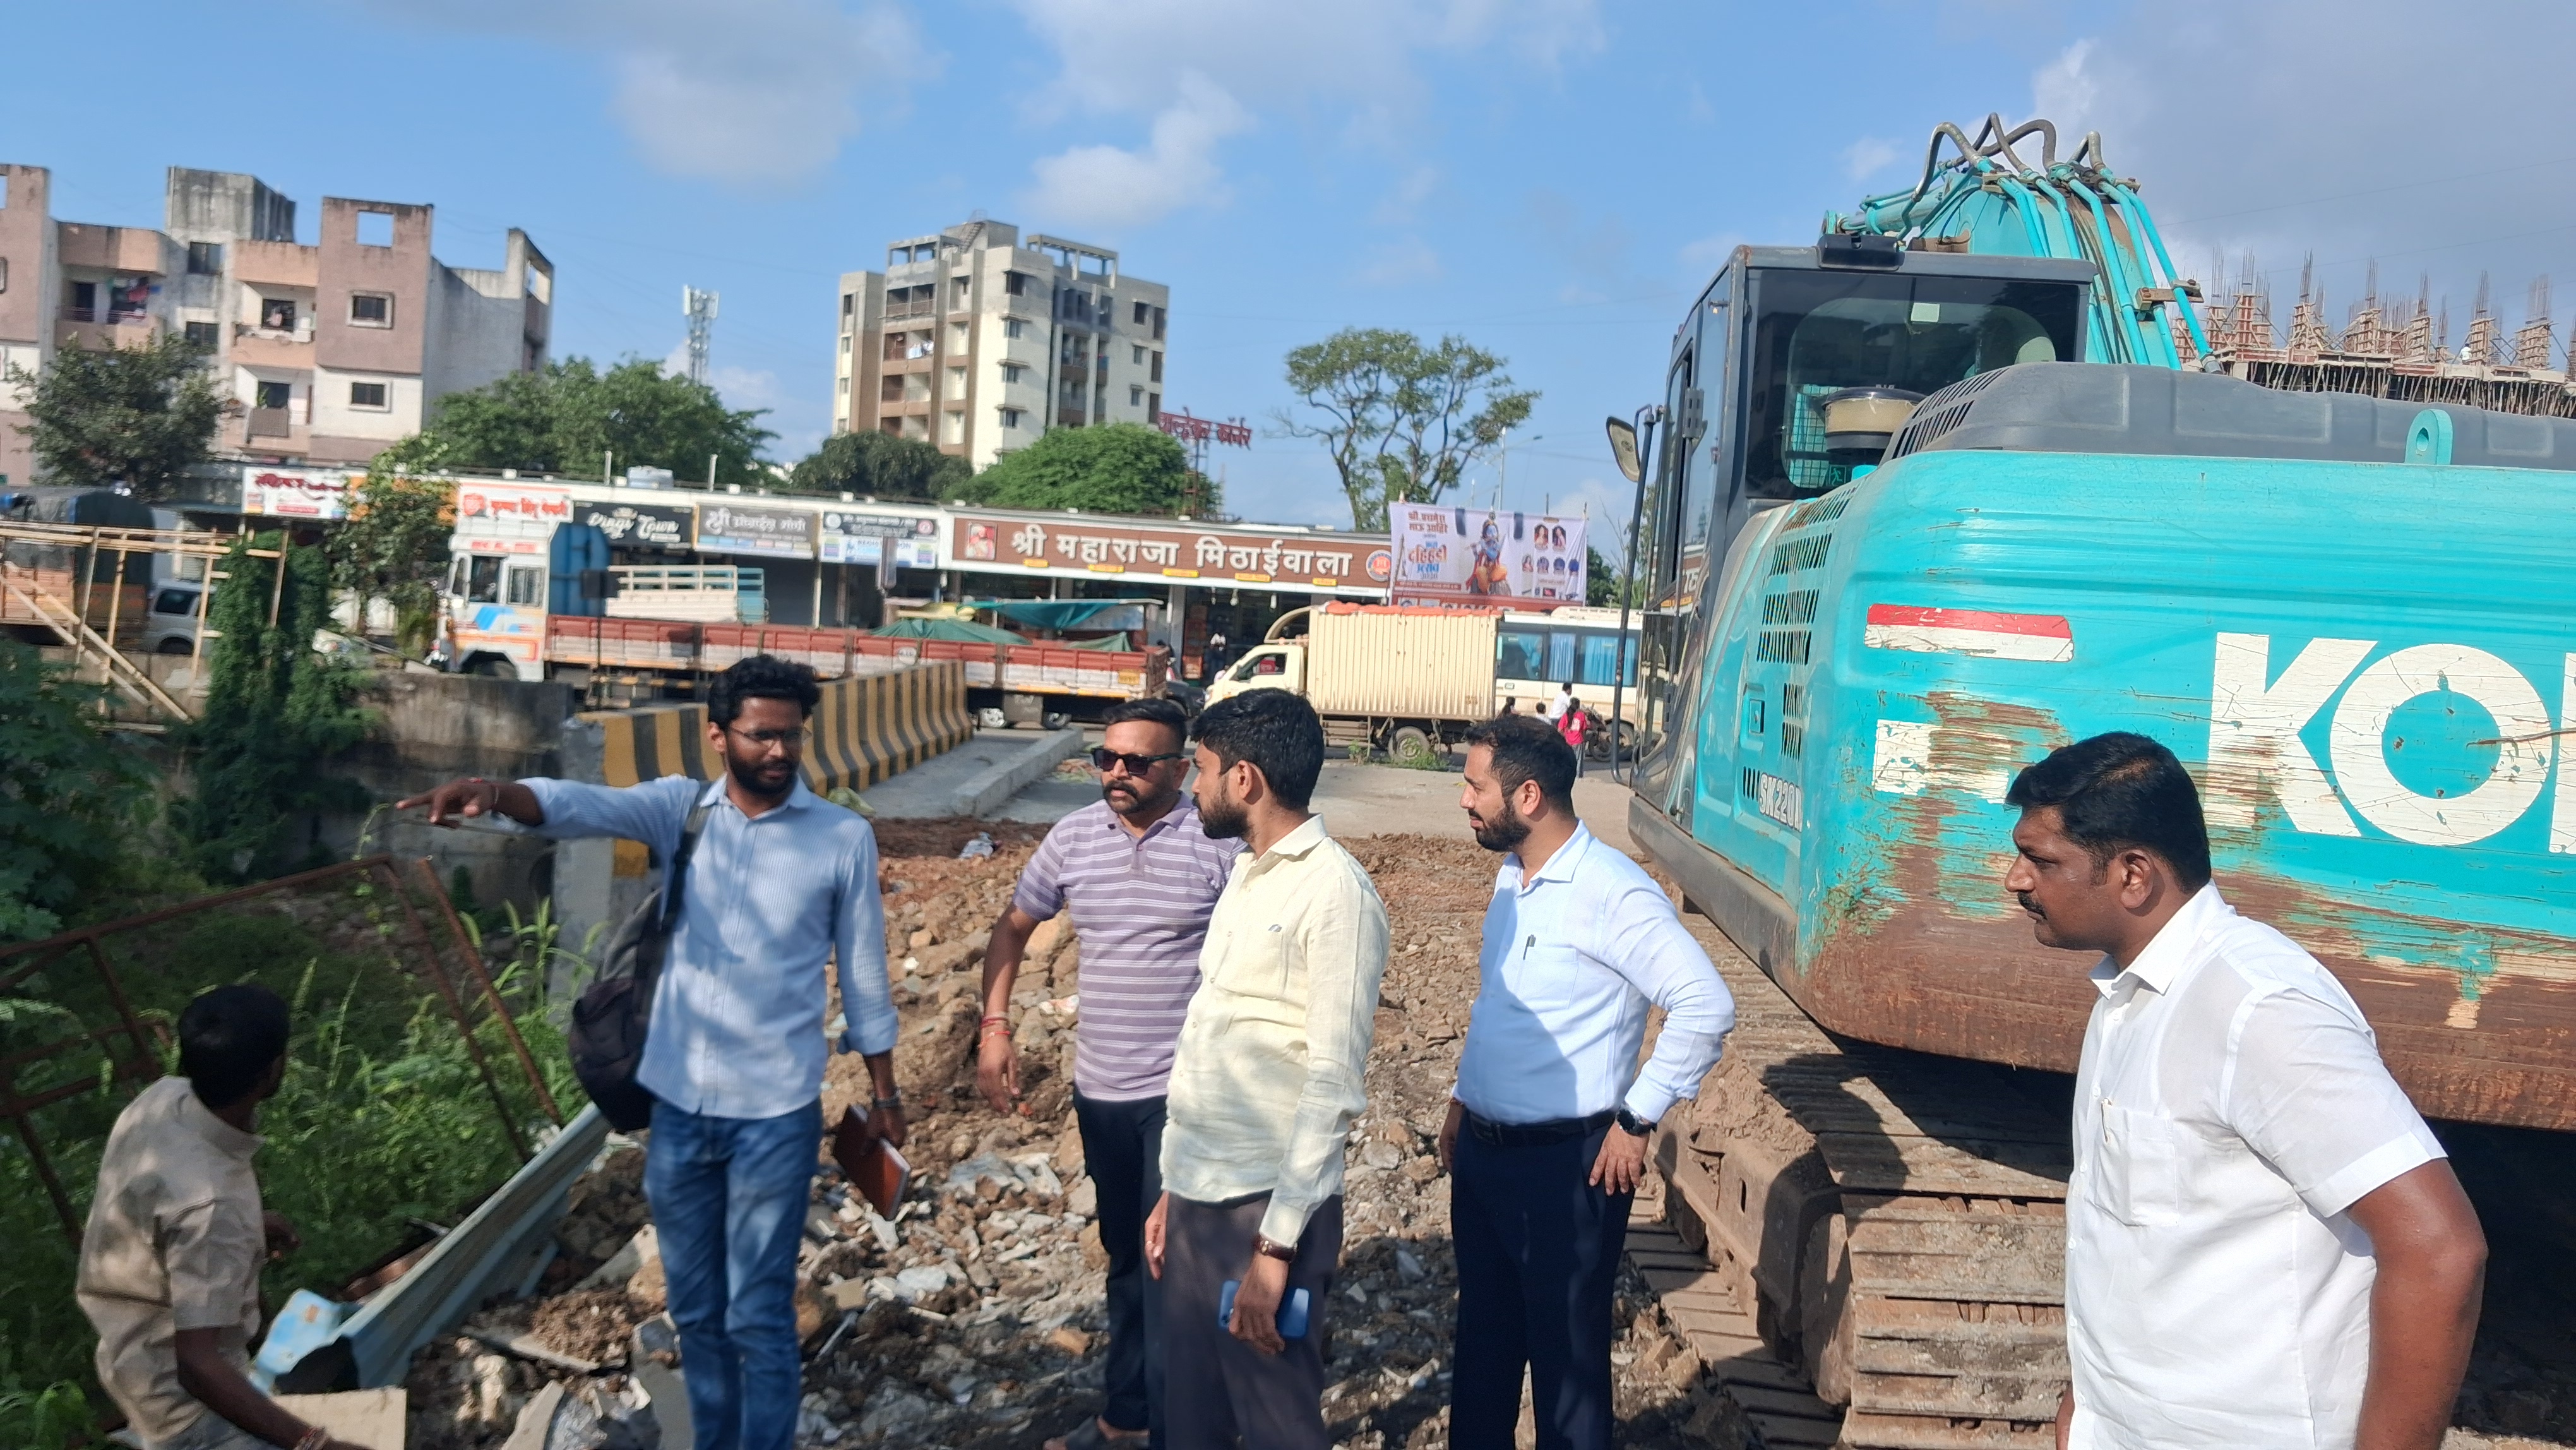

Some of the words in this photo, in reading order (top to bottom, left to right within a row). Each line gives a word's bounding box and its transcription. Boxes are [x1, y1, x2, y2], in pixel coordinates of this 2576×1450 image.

[1011, 524, 1048, 558] श्री
[1056, 534, 1181, 566] महाराजा
[1195, 535, 1354, 577] मिठाईवाला
